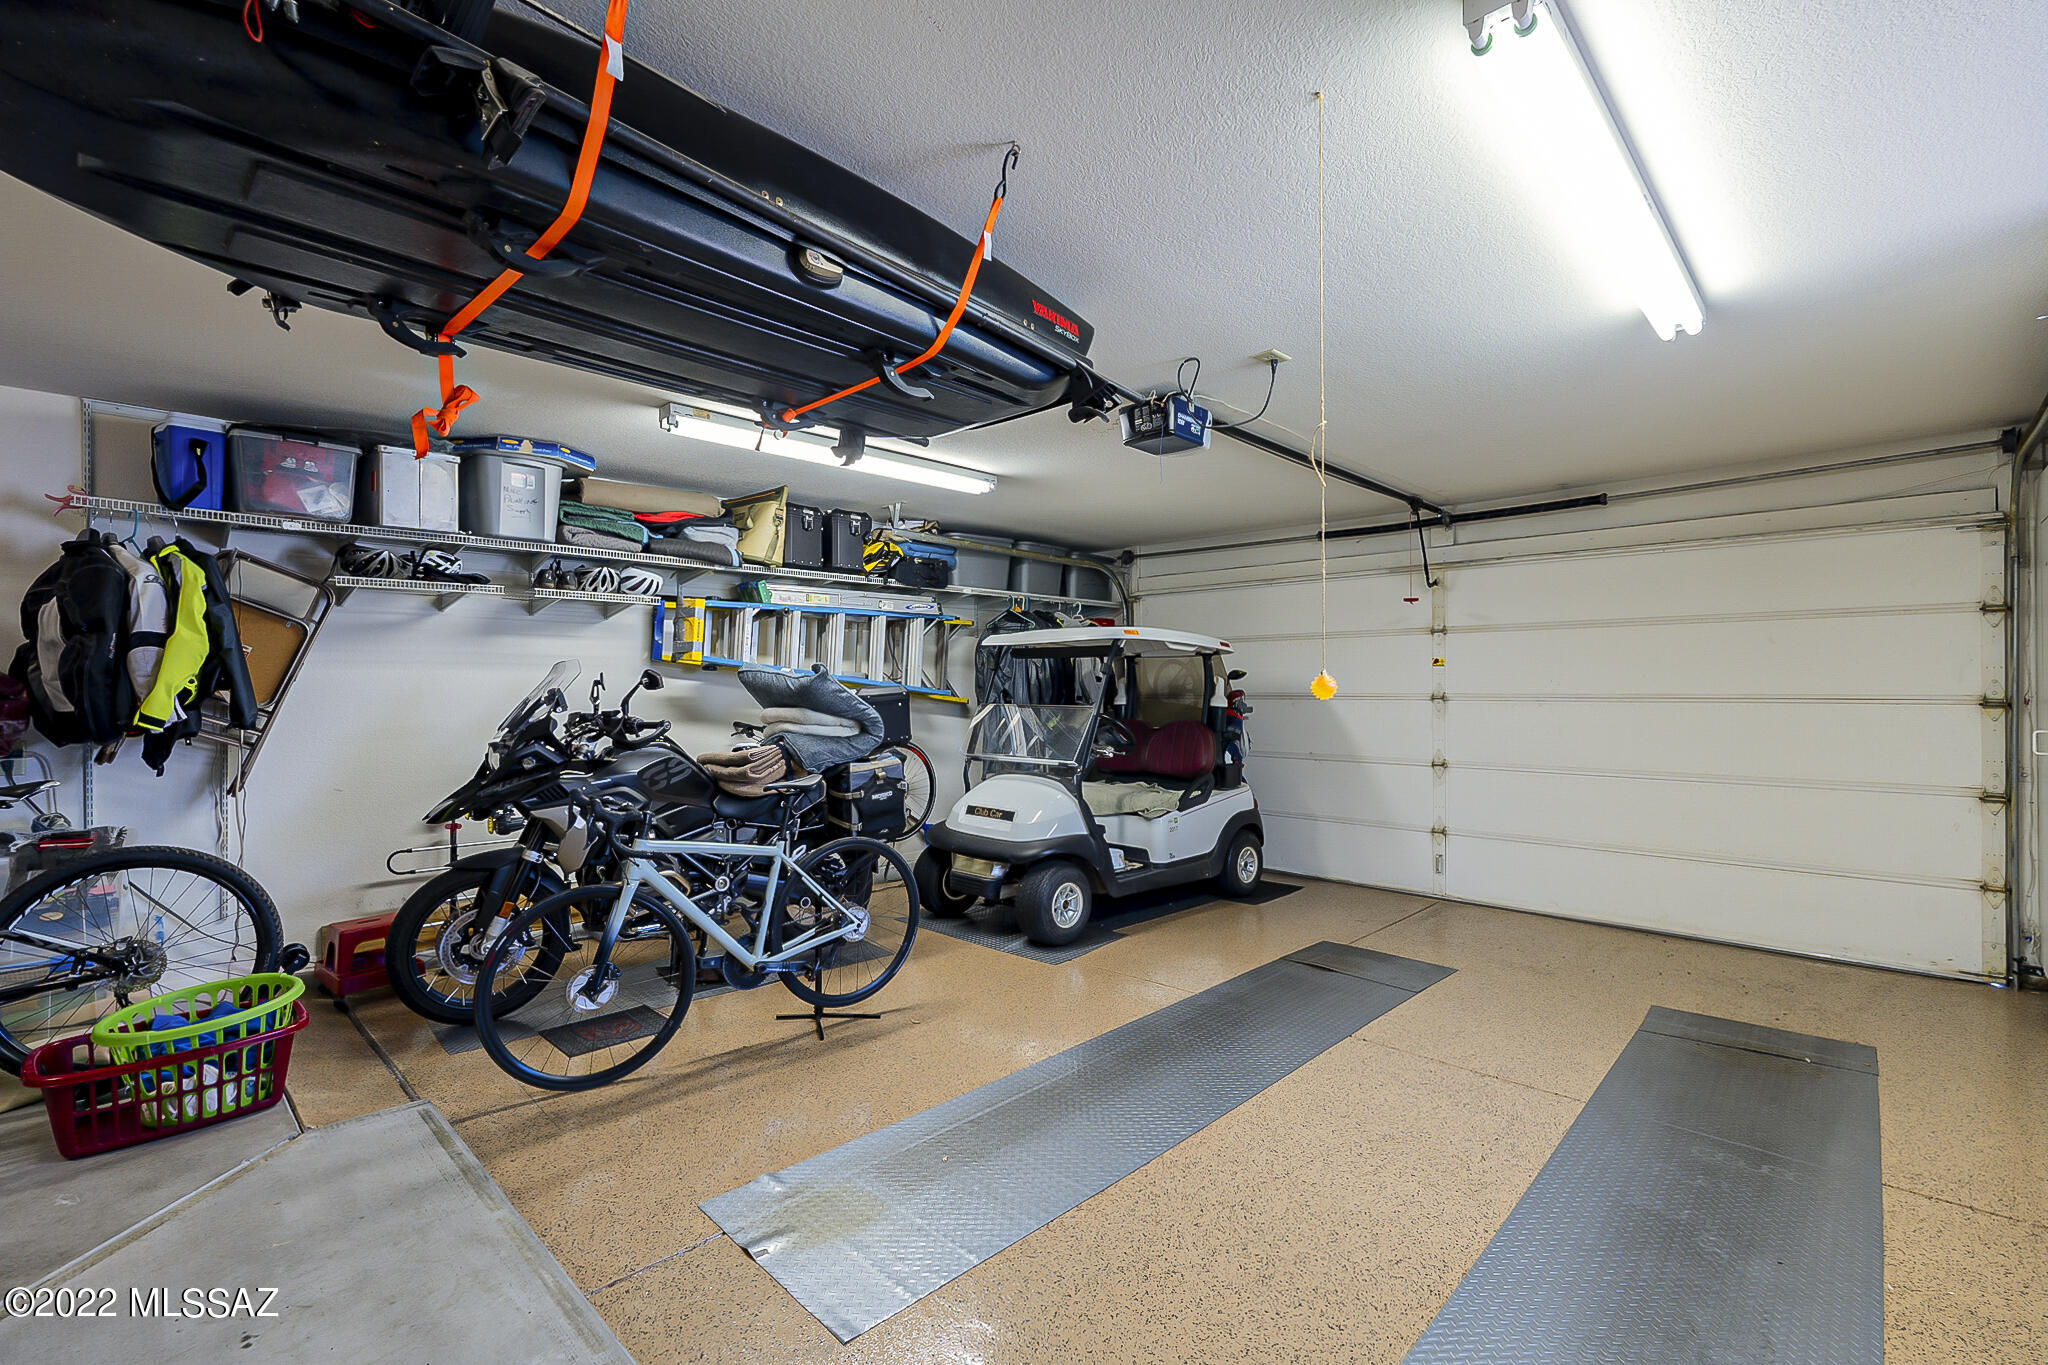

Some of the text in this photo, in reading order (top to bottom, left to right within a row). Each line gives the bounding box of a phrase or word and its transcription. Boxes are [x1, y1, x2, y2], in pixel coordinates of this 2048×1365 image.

[1032, 299, 1080, 338] YAKIMA
[974, 807, 1003, 819] Club Car
